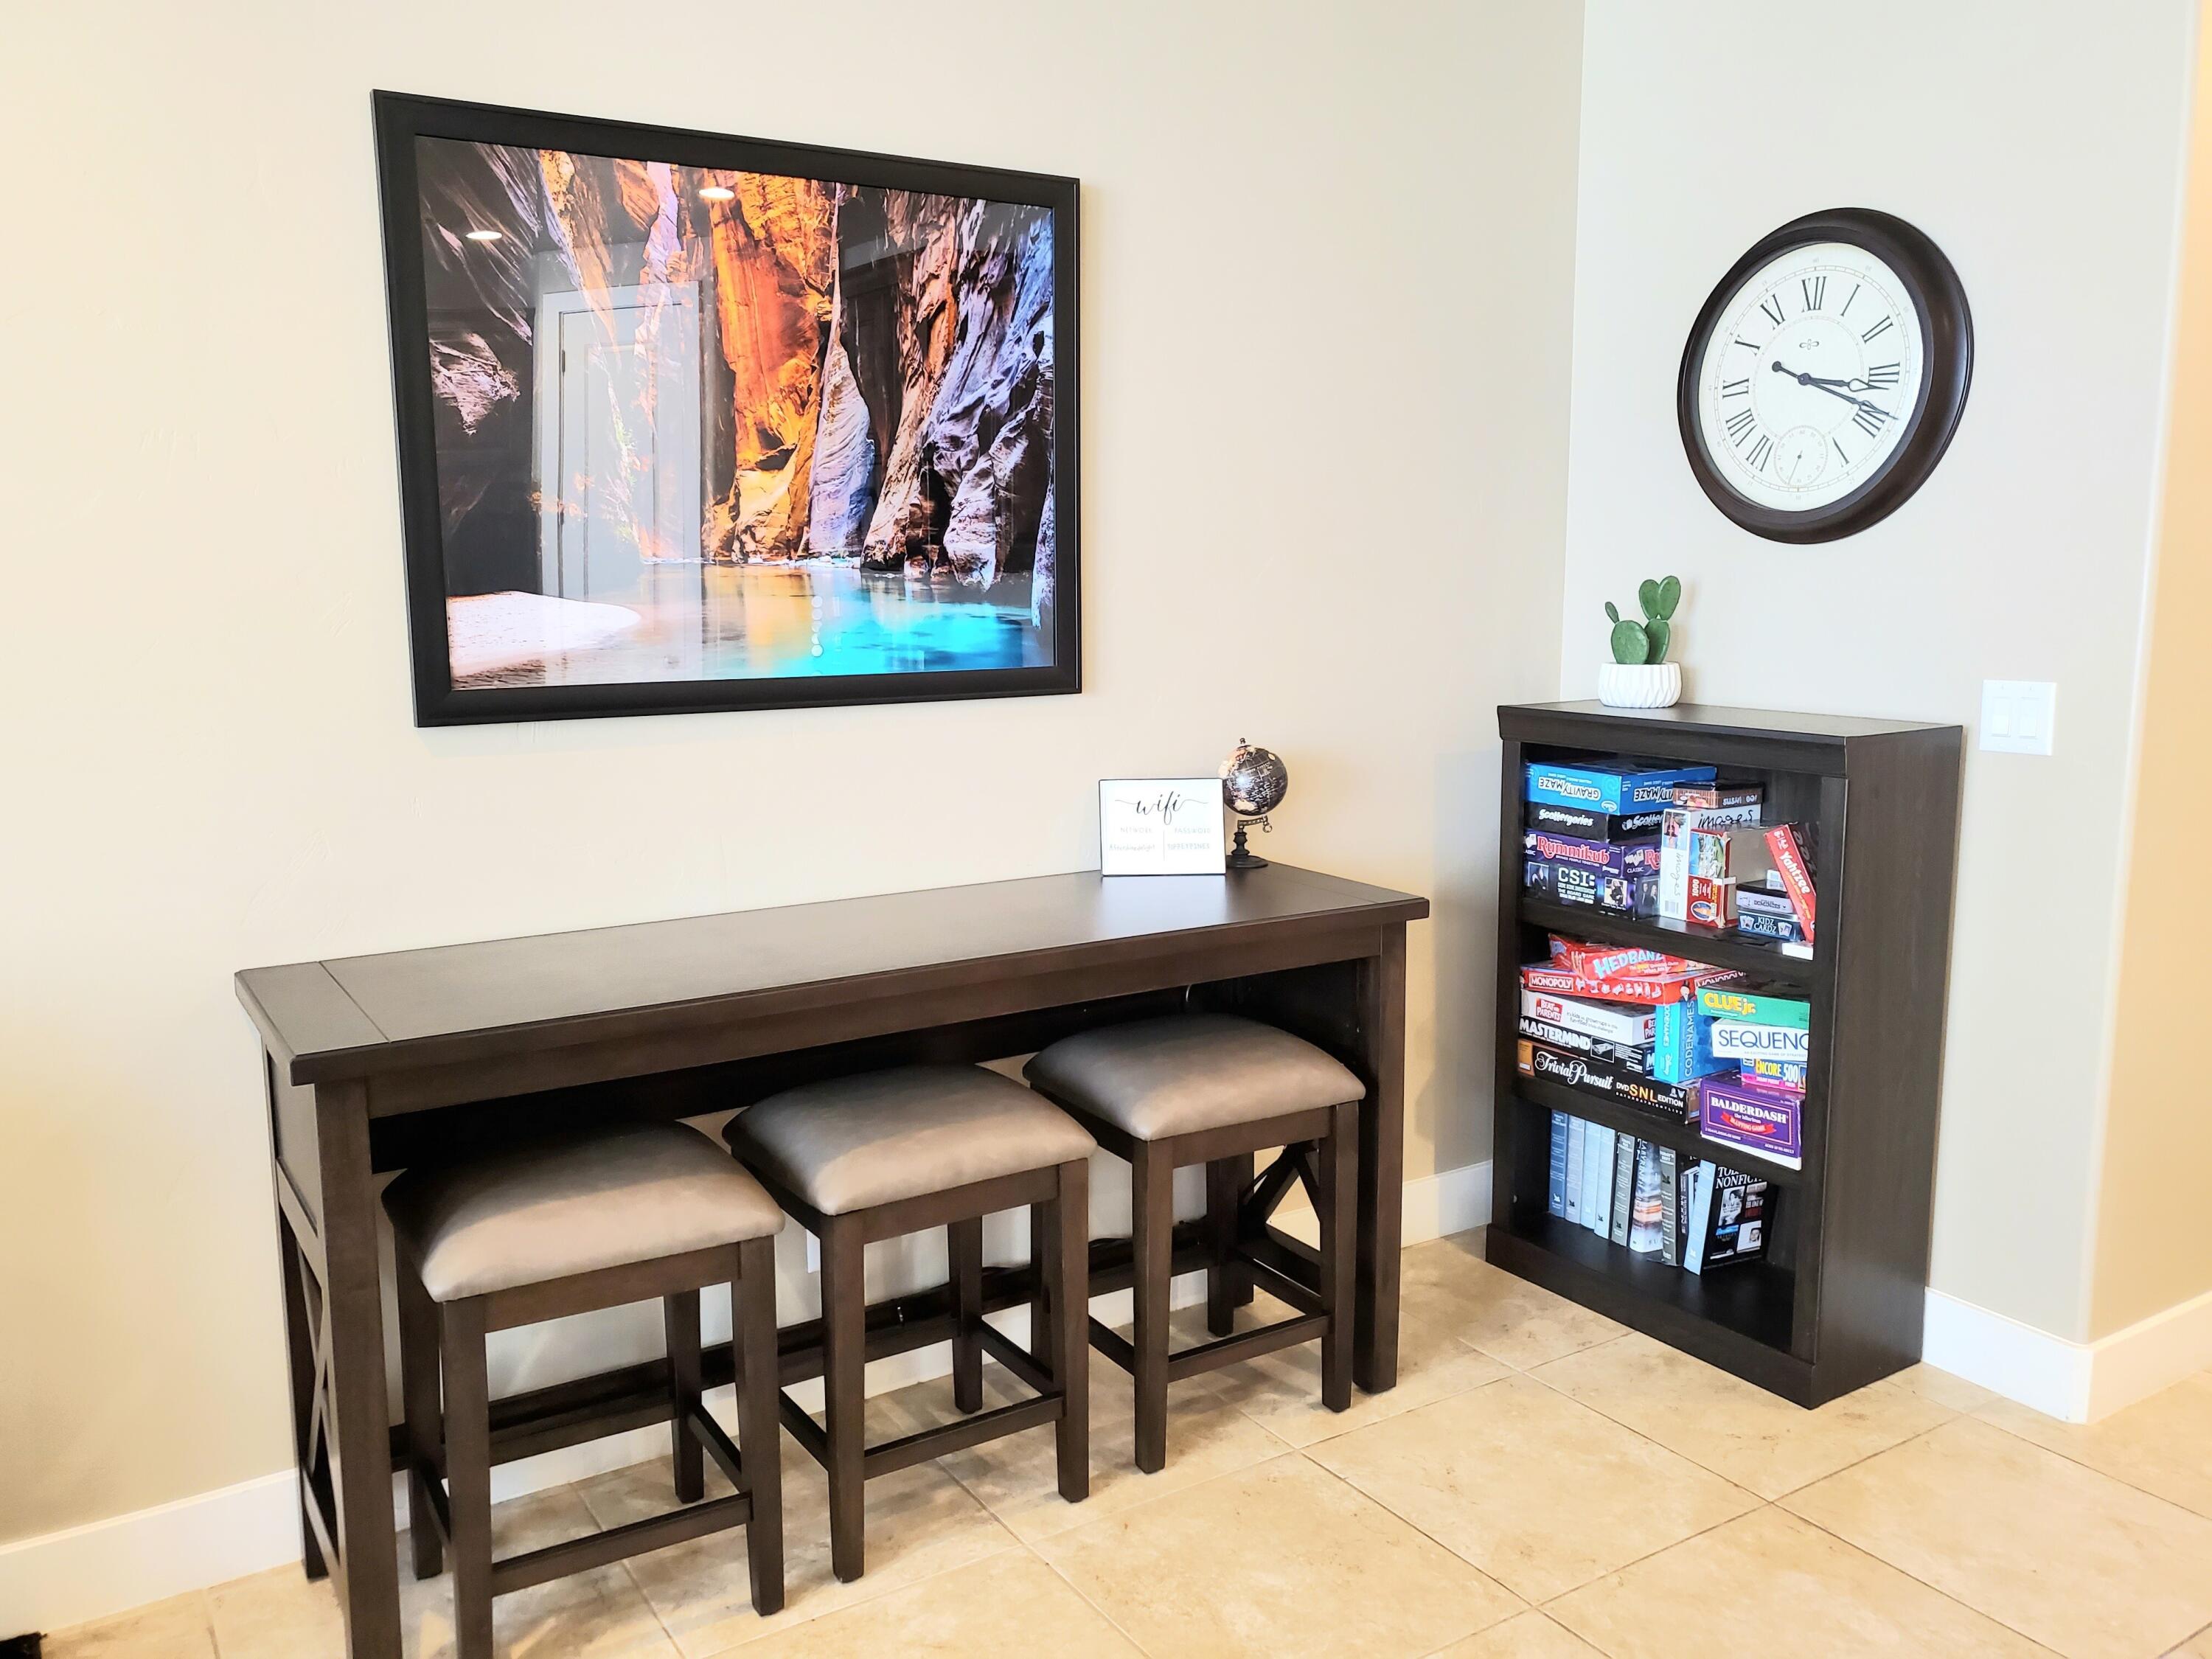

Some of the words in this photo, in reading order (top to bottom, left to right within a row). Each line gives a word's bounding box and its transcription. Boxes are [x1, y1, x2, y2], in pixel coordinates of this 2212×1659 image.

[1801, 276, 1827, 313] XII
[1538, 776, 1565, 792] MAZE
[1560, 783, 1601, 801] GRAVITY
[1634, 787, 1659, 801] MAZE
[1539, 809, 1593, 826] Scattergories
[1537, 836, 1610, 864] Rummikub
[1558, 867, 1596, 887] CSI:
[1779, 851, 1810, 894] Yahtzee
[1754, 922, 1777, 933] CARDZ
[1758, 917, 1775, 926] KIDZ
[1531, 976, 1572, 990] MONOPOLY
[1541, 1000, 1554, 1010] BEAT
[1704, 992, 1742, 1012] CLUE
[1537, 1007, 1562, 1022] PARENTS
[1520, 1018, 1591, 1051] MASTERMIND
[1685, 1000, 1695, 1077] CODENAMES
[1719, 1029, 1809, 1051] SEQUENC
[1535, 1051, 1572, 1077] Trivial
[1568, 1060, 1613, 1090] Pursuit
[1616, 1082, 1630, 1091] DVD
[1630, 1084, 1658, 1103] SNL
[1658, 1094, 1683, 1107] EDITION
[1756, 1059, 1781, 1077] ENCORE
[1783, 1063, 1798, 1082] 500
[1711, 1096, 1787, 1124] BALDERDASH
[1716, 1174, 1762, 1189] NONFIC
